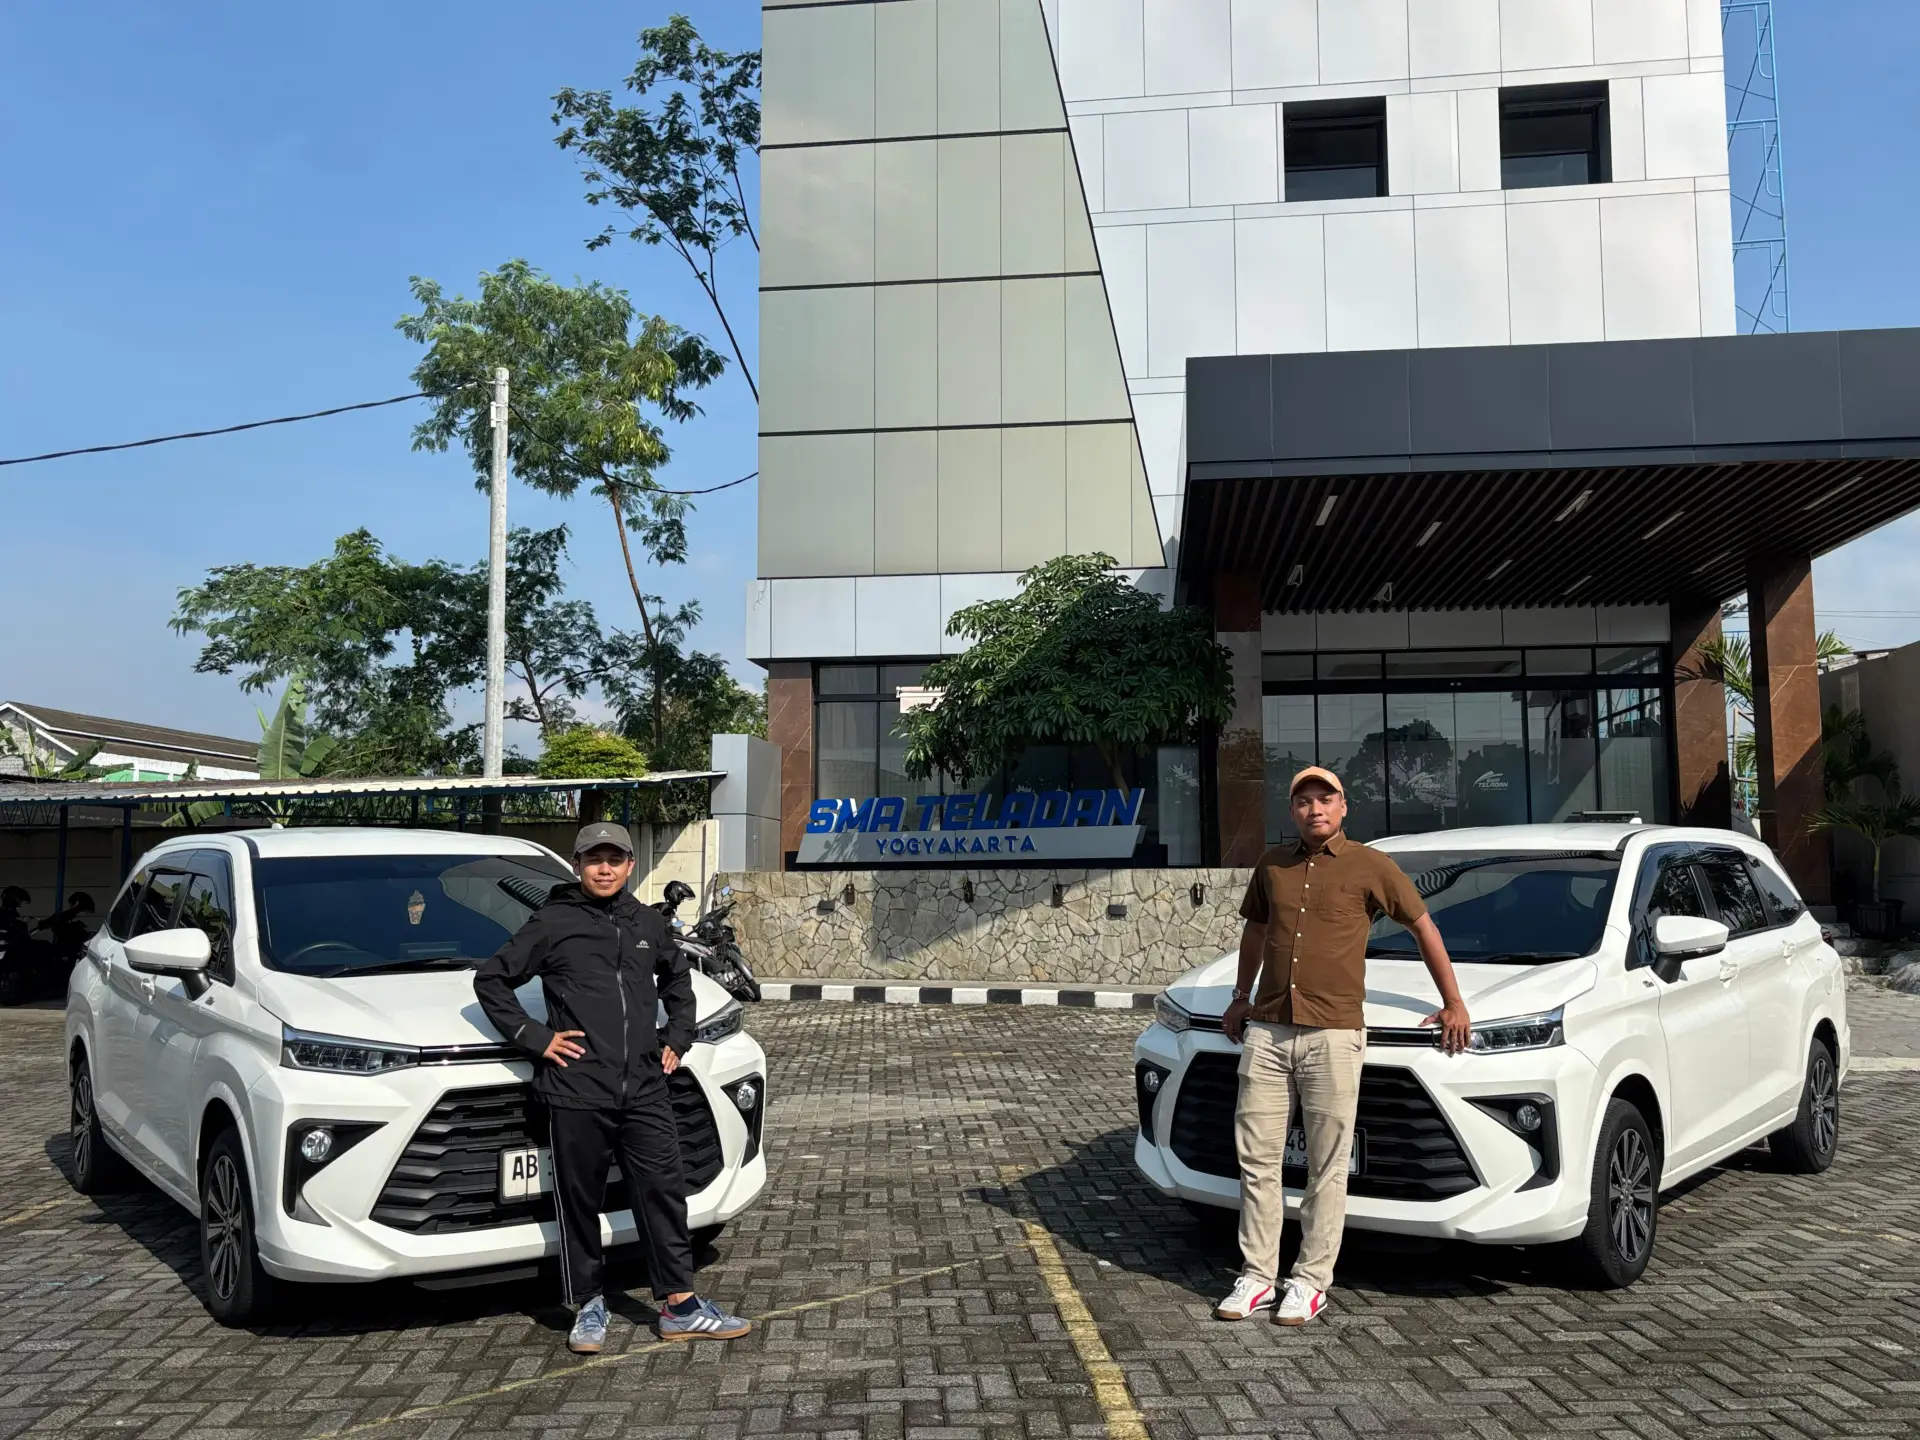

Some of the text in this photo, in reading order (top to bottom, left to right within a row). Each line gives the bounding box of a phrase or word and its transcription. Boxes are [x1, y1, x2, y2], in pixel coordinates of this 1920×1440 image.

[806, 788, 1144, 833] SMA TELADAN
[876, 836, 1037, 855] YOGYAKARTA
[512, 1154, 538, 1181] AB
